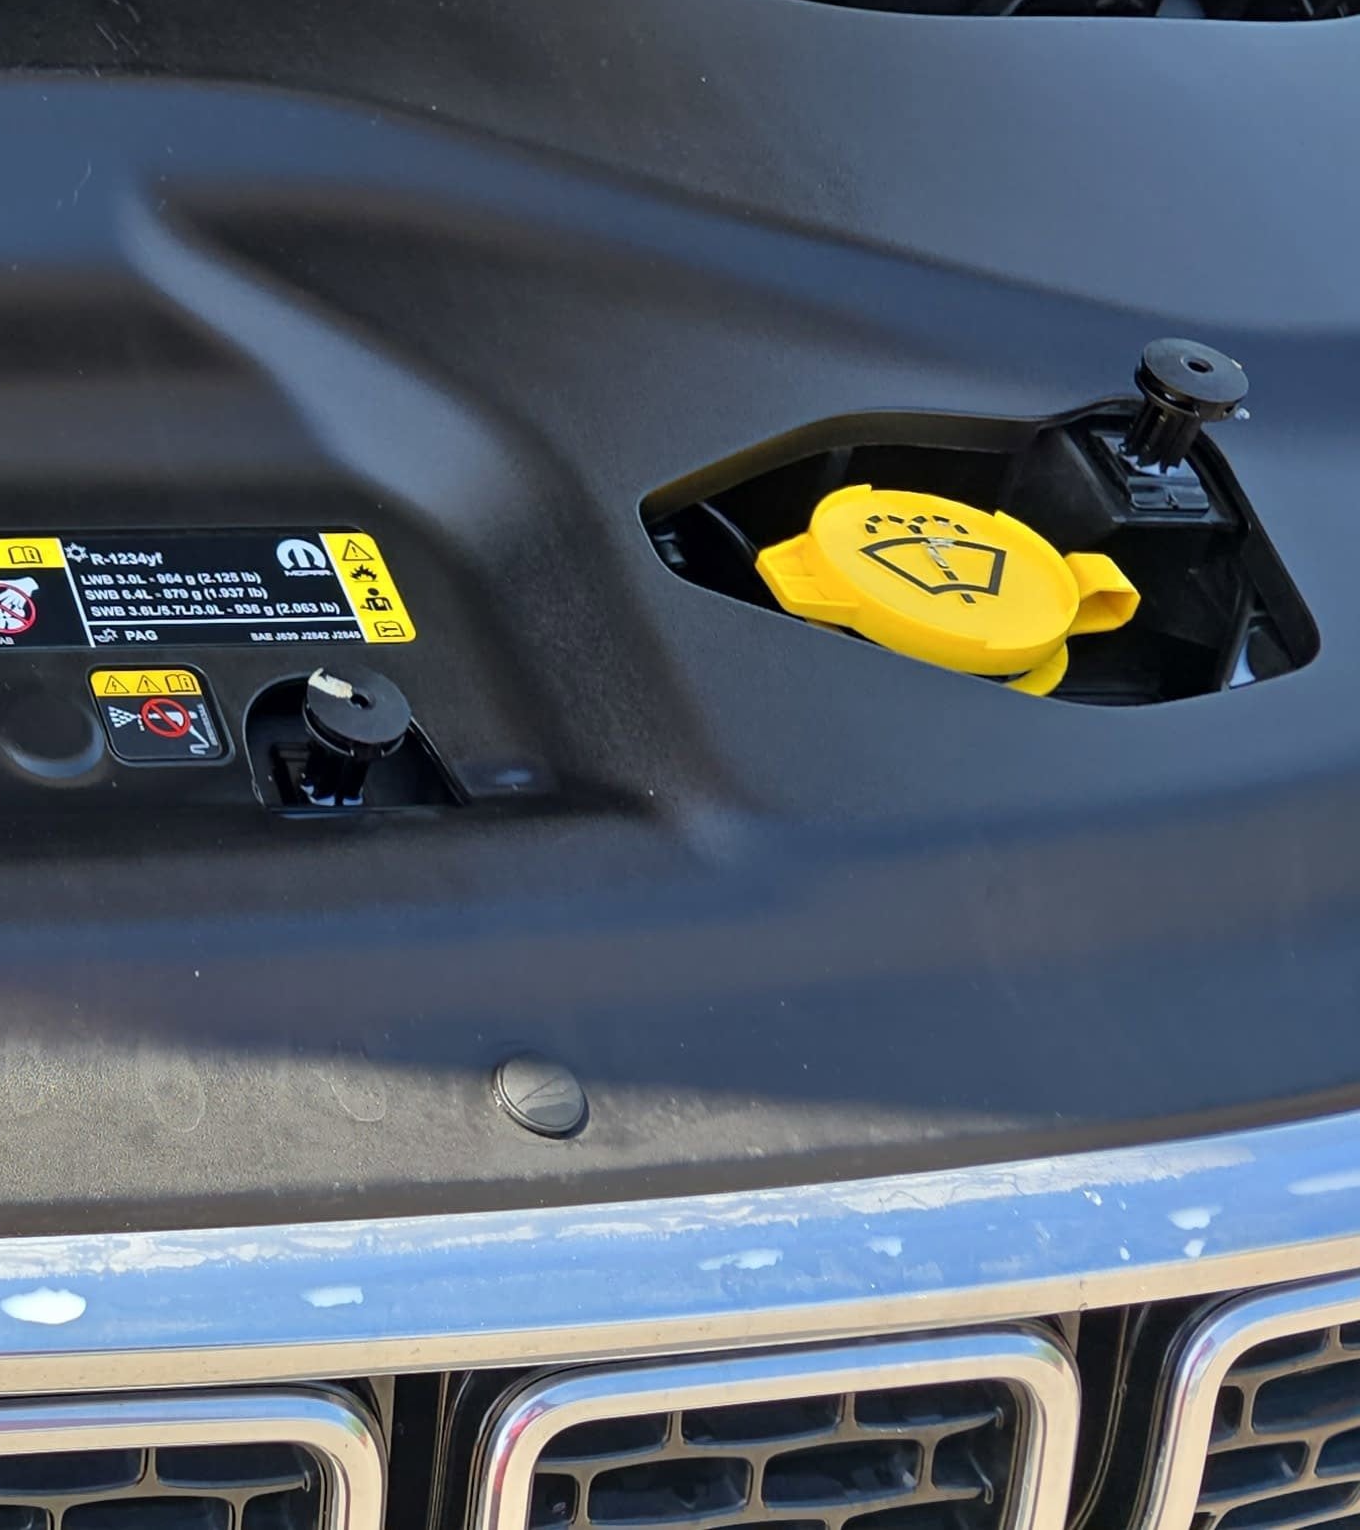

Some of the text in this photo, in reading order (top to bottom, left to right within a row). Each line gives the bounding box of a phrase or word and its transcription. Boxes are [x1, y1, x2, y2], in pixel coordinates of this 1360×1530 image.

[90, 552, 163, 567] R-1234yf
[81, 574, 114, 585] LWB
[115, 574, 147, 584] 3.0L
[184, 575, 196, 585] g
[197, 572, 240, 585] (2.125
[240, 571, 261, 584] lb)
[84, 590, 120, 600] SWB
[121, 589, 153, 600] 6.4L
[191, 590, 202, 601] g
[203, 587, 245, 601] (1.937
[247, 586, 268, 600] lb)
[90, 606, 125, 617] SWB
[127, 604, 224, 616] 3.6L/5.7L/3.0L
[263, 606, 274, 616] g
[275, 603, 319, 616] (2.063
[319, 602, 340, 615] lb)
[124, 630, 158, 641] PAG
